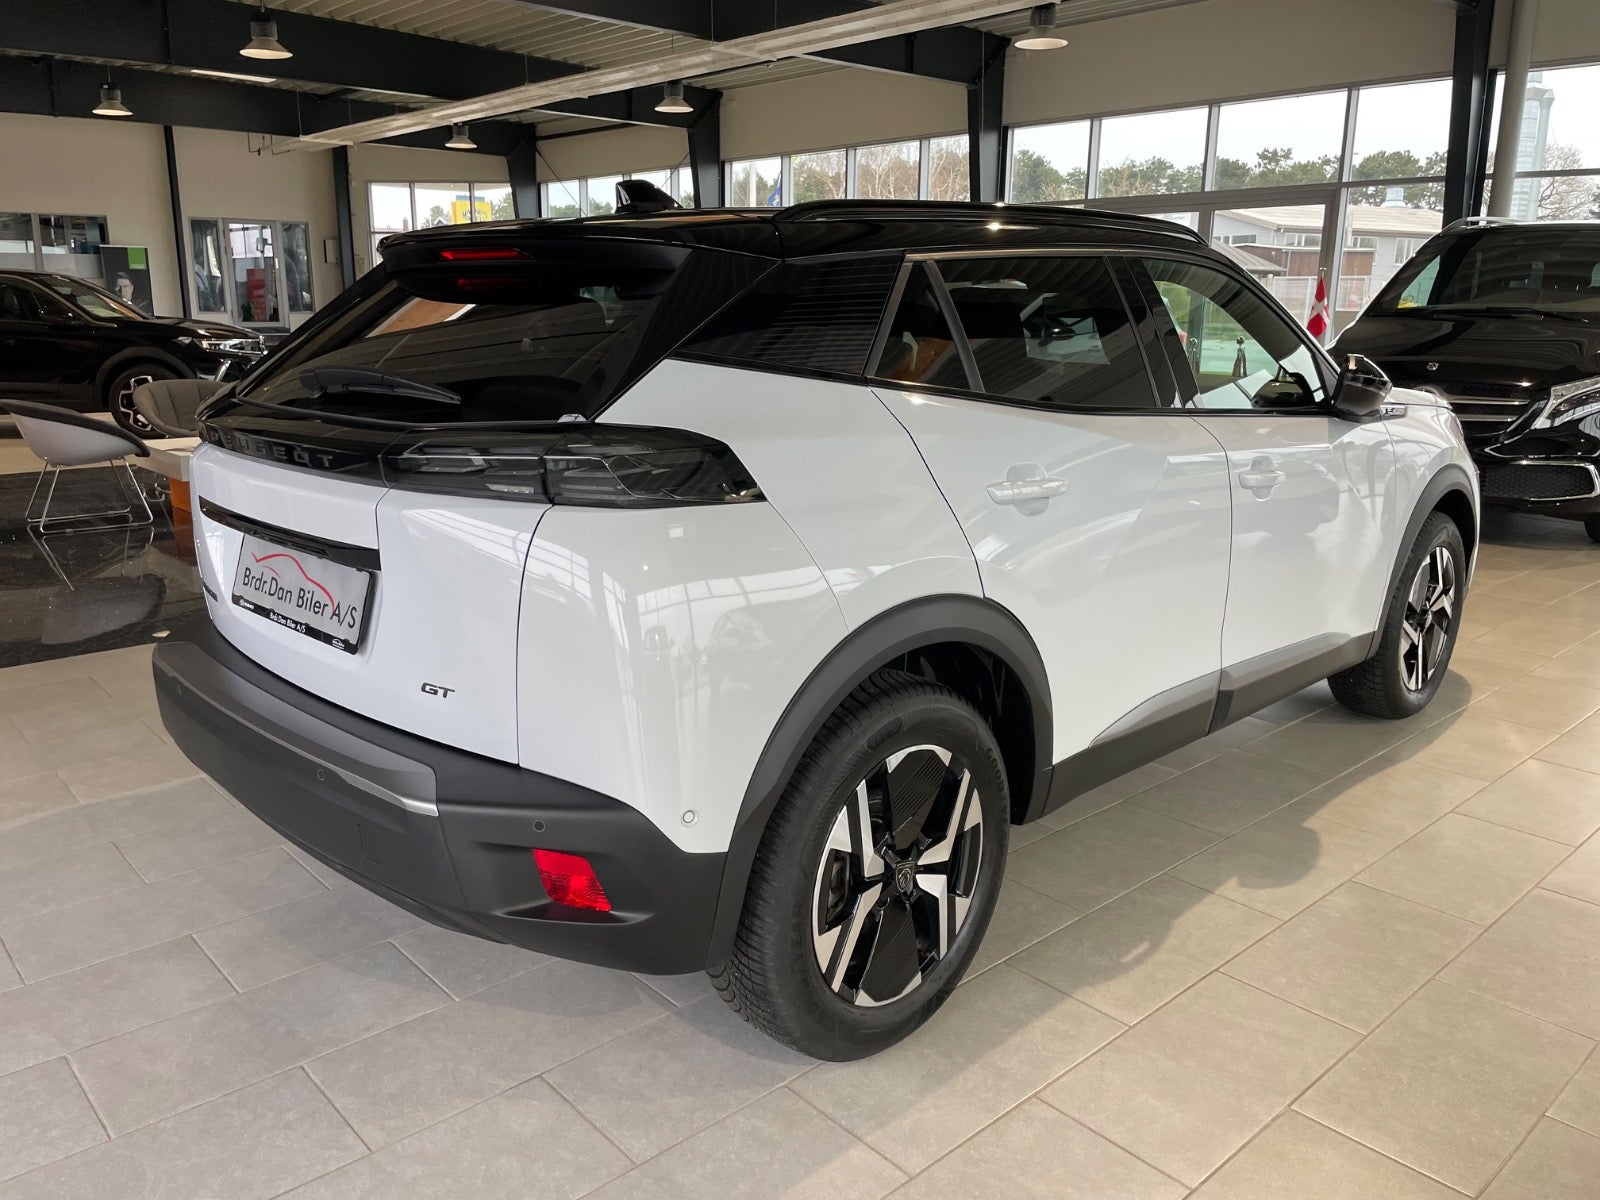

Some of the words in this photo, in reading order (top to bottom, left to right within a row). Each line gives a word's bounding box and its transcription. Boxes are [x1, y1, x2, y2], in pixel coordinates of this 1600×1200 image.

[209, 428, 333, 467] PEUGEOT
[297, 587, 328, 617] Biler
[330, 602, 358, 629] A/S
[296, 623, 306, 633] A/S
[421, 682, 456, 698] GT
